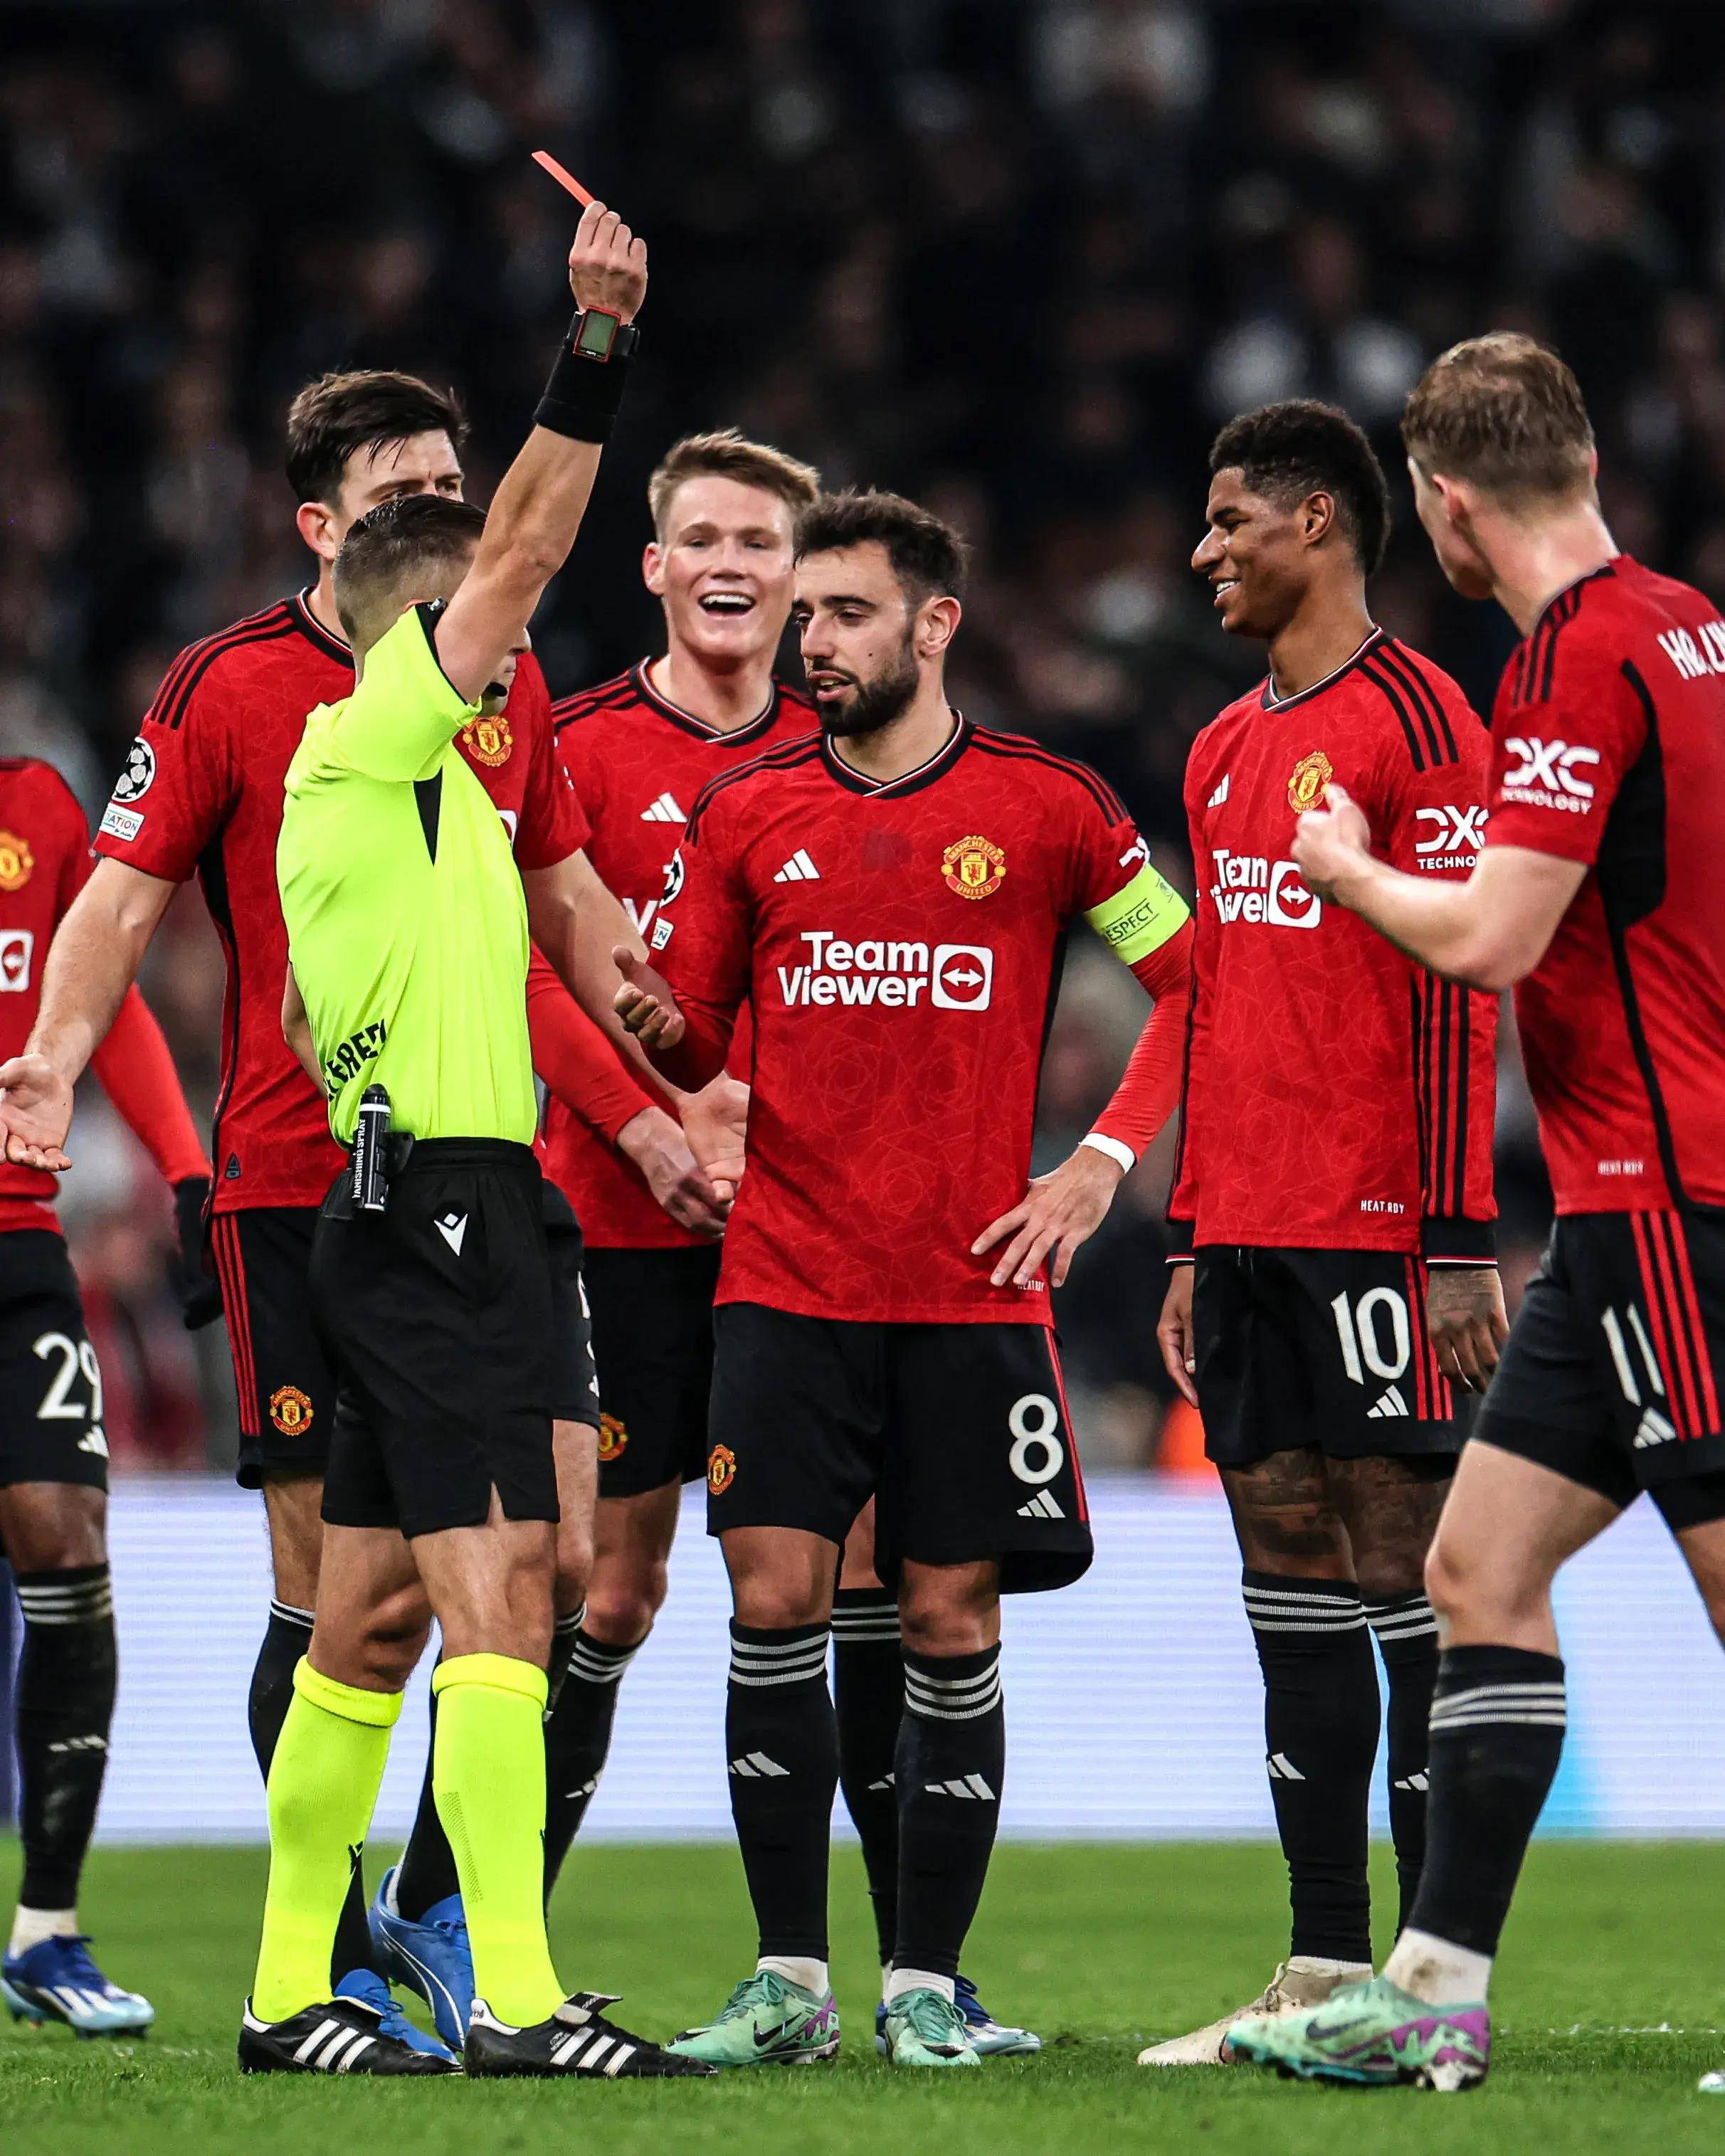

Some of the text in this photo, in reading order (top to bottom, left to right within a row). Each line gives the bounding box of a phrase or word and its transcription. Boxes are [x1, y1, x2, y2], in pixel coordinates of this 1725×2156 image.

[947, 839, 1001, 862] MANCHESTER
[1417, 855, 1477, 870] TECHNO
[956, 883, 992, 895] UNITED
[1104, 902, 1154, 941] ESPECT
[801, 931, 929, 973] Team
[777, 965, 928, 1007] Viewer
[357, 1119, 366, 1148] SPRAY
[1360, 1200, 1405, 1215] HEAT.RDY
[1330, 1287, 1410, 1385] 10
[1601, 1301, 1665, 1407] 11
[31, 1331, 103, 1422] 29
[1008, 1393, 1064, 1484] 8
